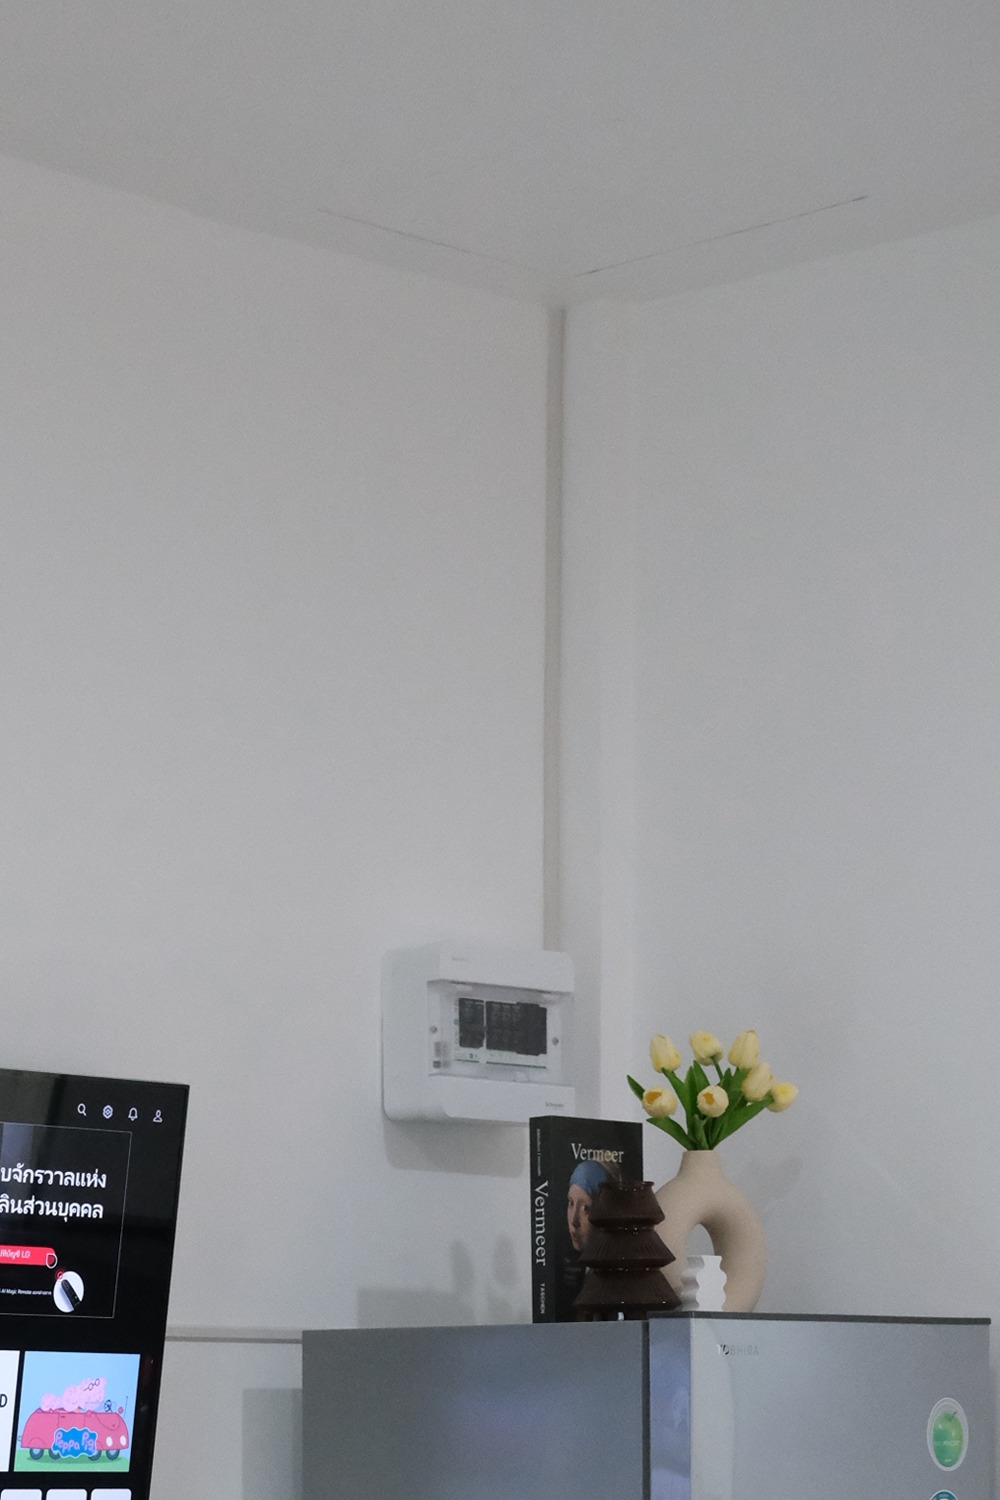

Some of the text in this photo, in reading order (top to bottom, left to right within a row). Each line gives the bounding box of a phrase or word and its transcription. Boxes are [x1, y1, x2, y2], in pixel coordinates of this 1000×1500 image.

[571, 1143, 625, 1163] Vermeer
[534, 1180, 549, 1266] Vermeer
[21, 1250, 30, 1258] LG
[55, 1431, 96, 1453] Peppa Pig
